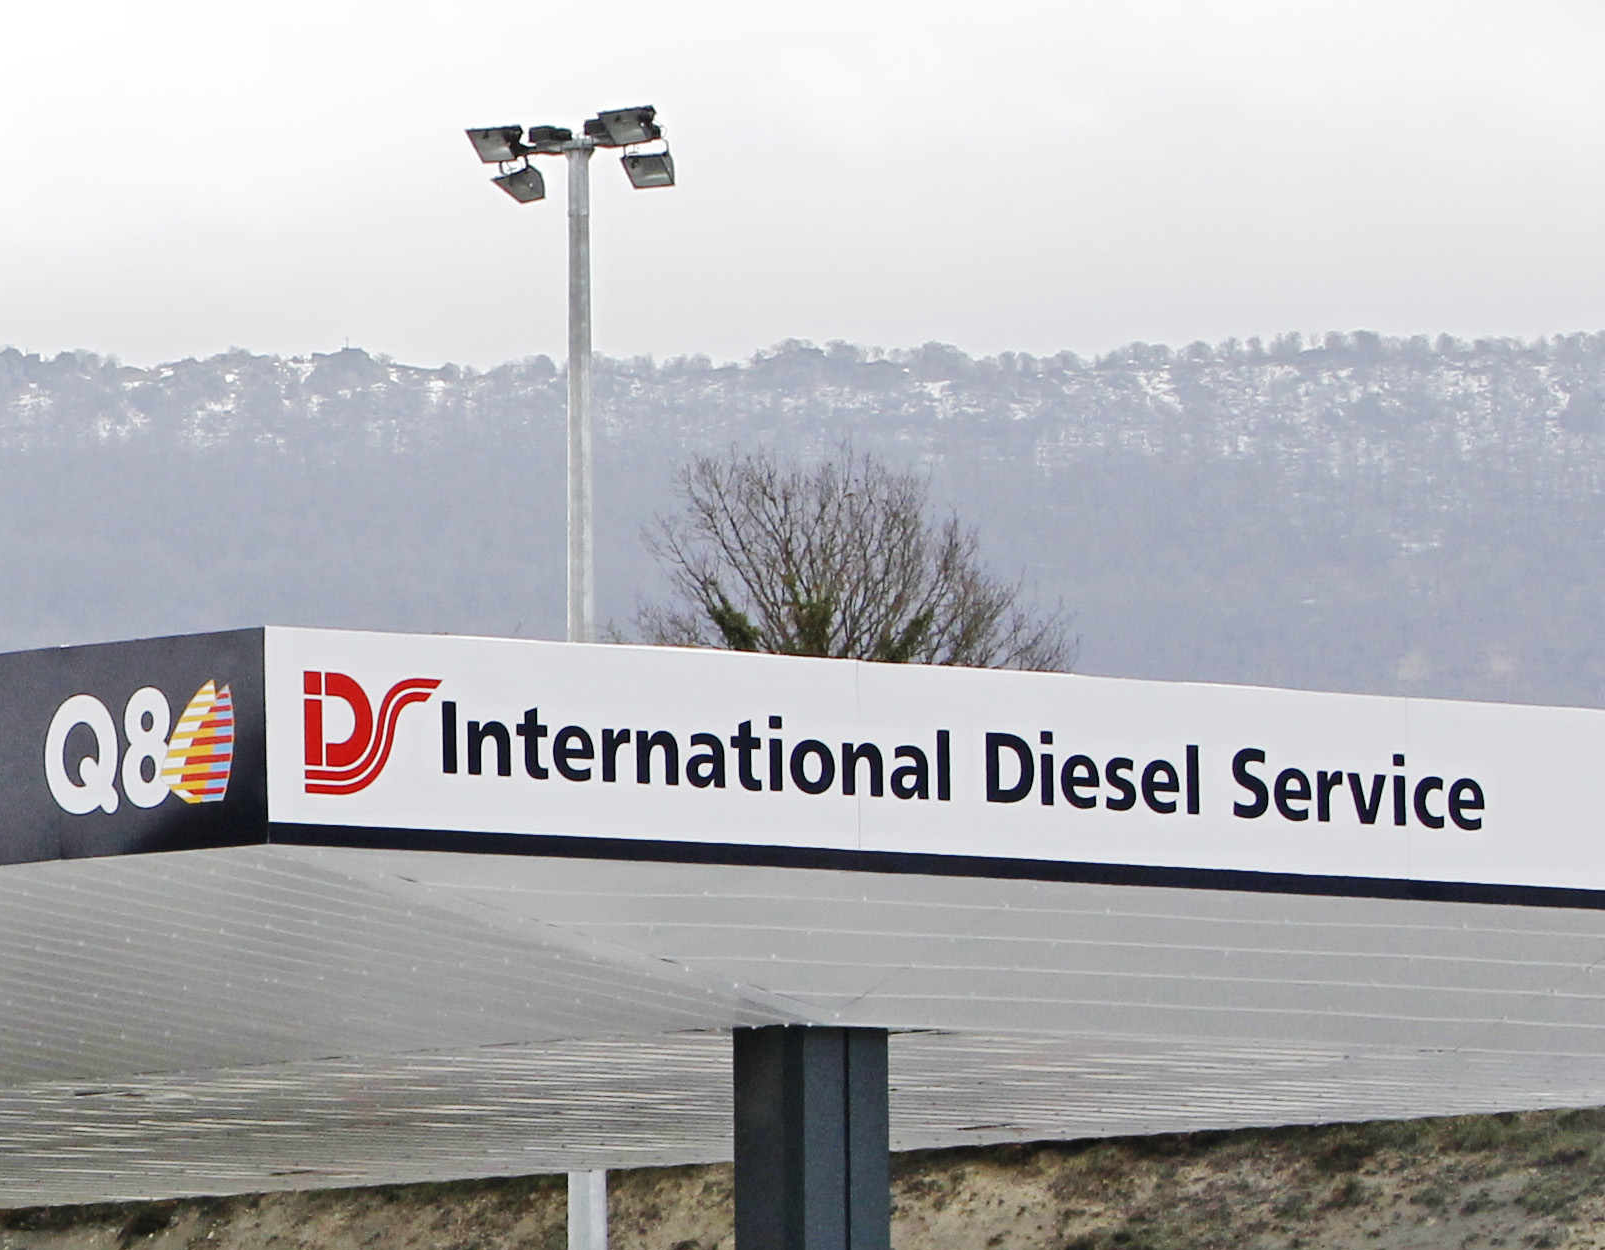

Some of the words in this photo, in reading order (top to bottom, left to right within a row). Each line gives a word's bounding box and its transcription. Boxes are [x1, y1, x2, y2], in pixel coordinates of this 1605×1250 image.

[44, 686, 172, 815] Q8
[441, 700, 951, 802] International
[986, 731, 1200, 815] Diesel
[1231, 748, 1485, 832] Service
